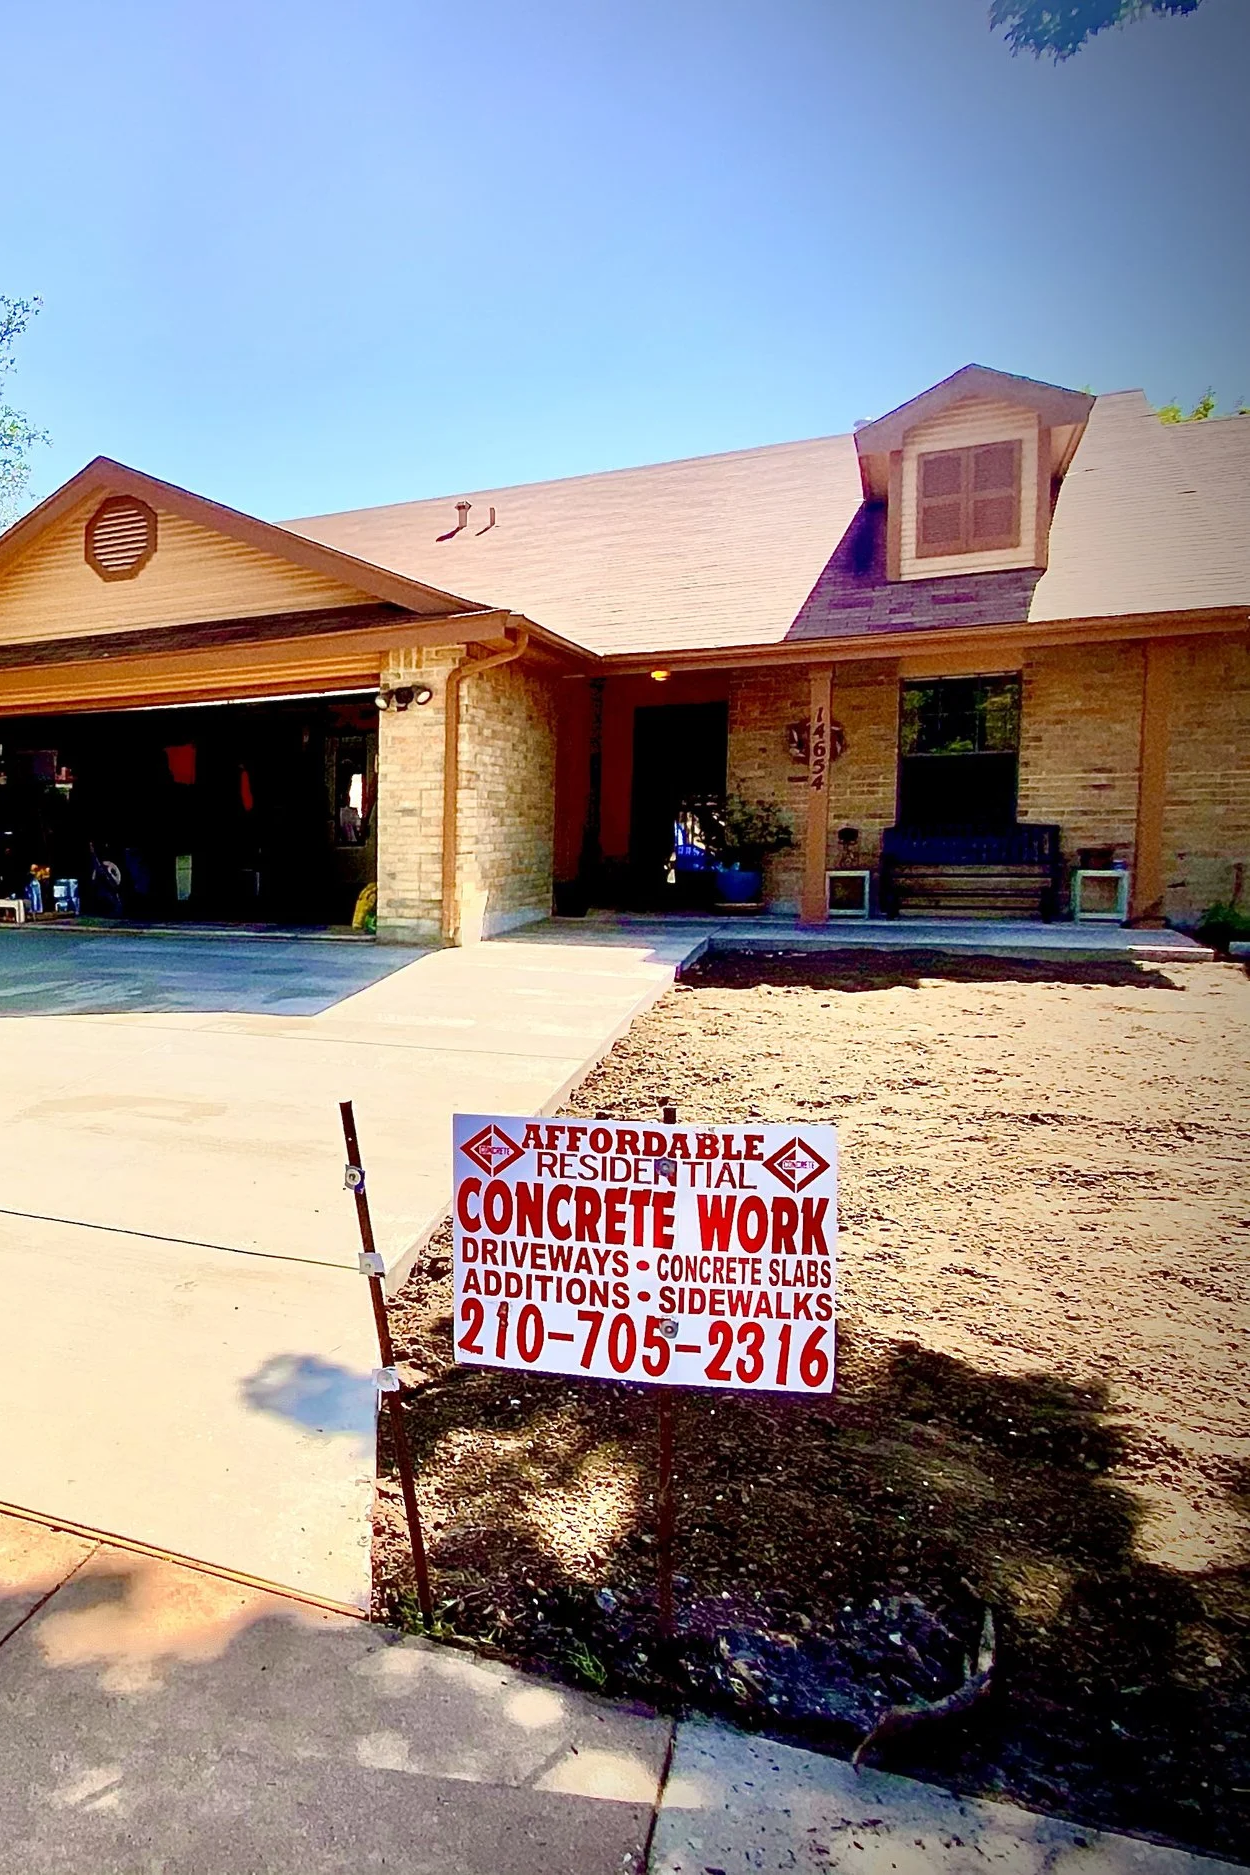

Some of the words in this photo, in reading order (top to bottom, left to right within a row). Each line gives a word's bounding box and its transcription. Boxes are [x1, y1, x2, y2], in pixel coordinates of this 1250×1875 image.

[521, 1123, 765, 1162] AFFORDABLE
[536, 1151, 758, 1190] RESIDENTIAL
[457, 1176, 676, 1250] CONCRETE
[696, 1194, 830, 1256] WORK
[461, 1236, 630, 1278] DRIVEWAYS
[656, 1253, 762, 1287] CONCRETE
[768, 1258, 832, 1289] SLABS
[462, 1268, 630, 1311] ADDITIONS
[658, 1287, 833, 1322] SIDEWALKS
[457, 1297, 829, 1389] 210-705-2316
